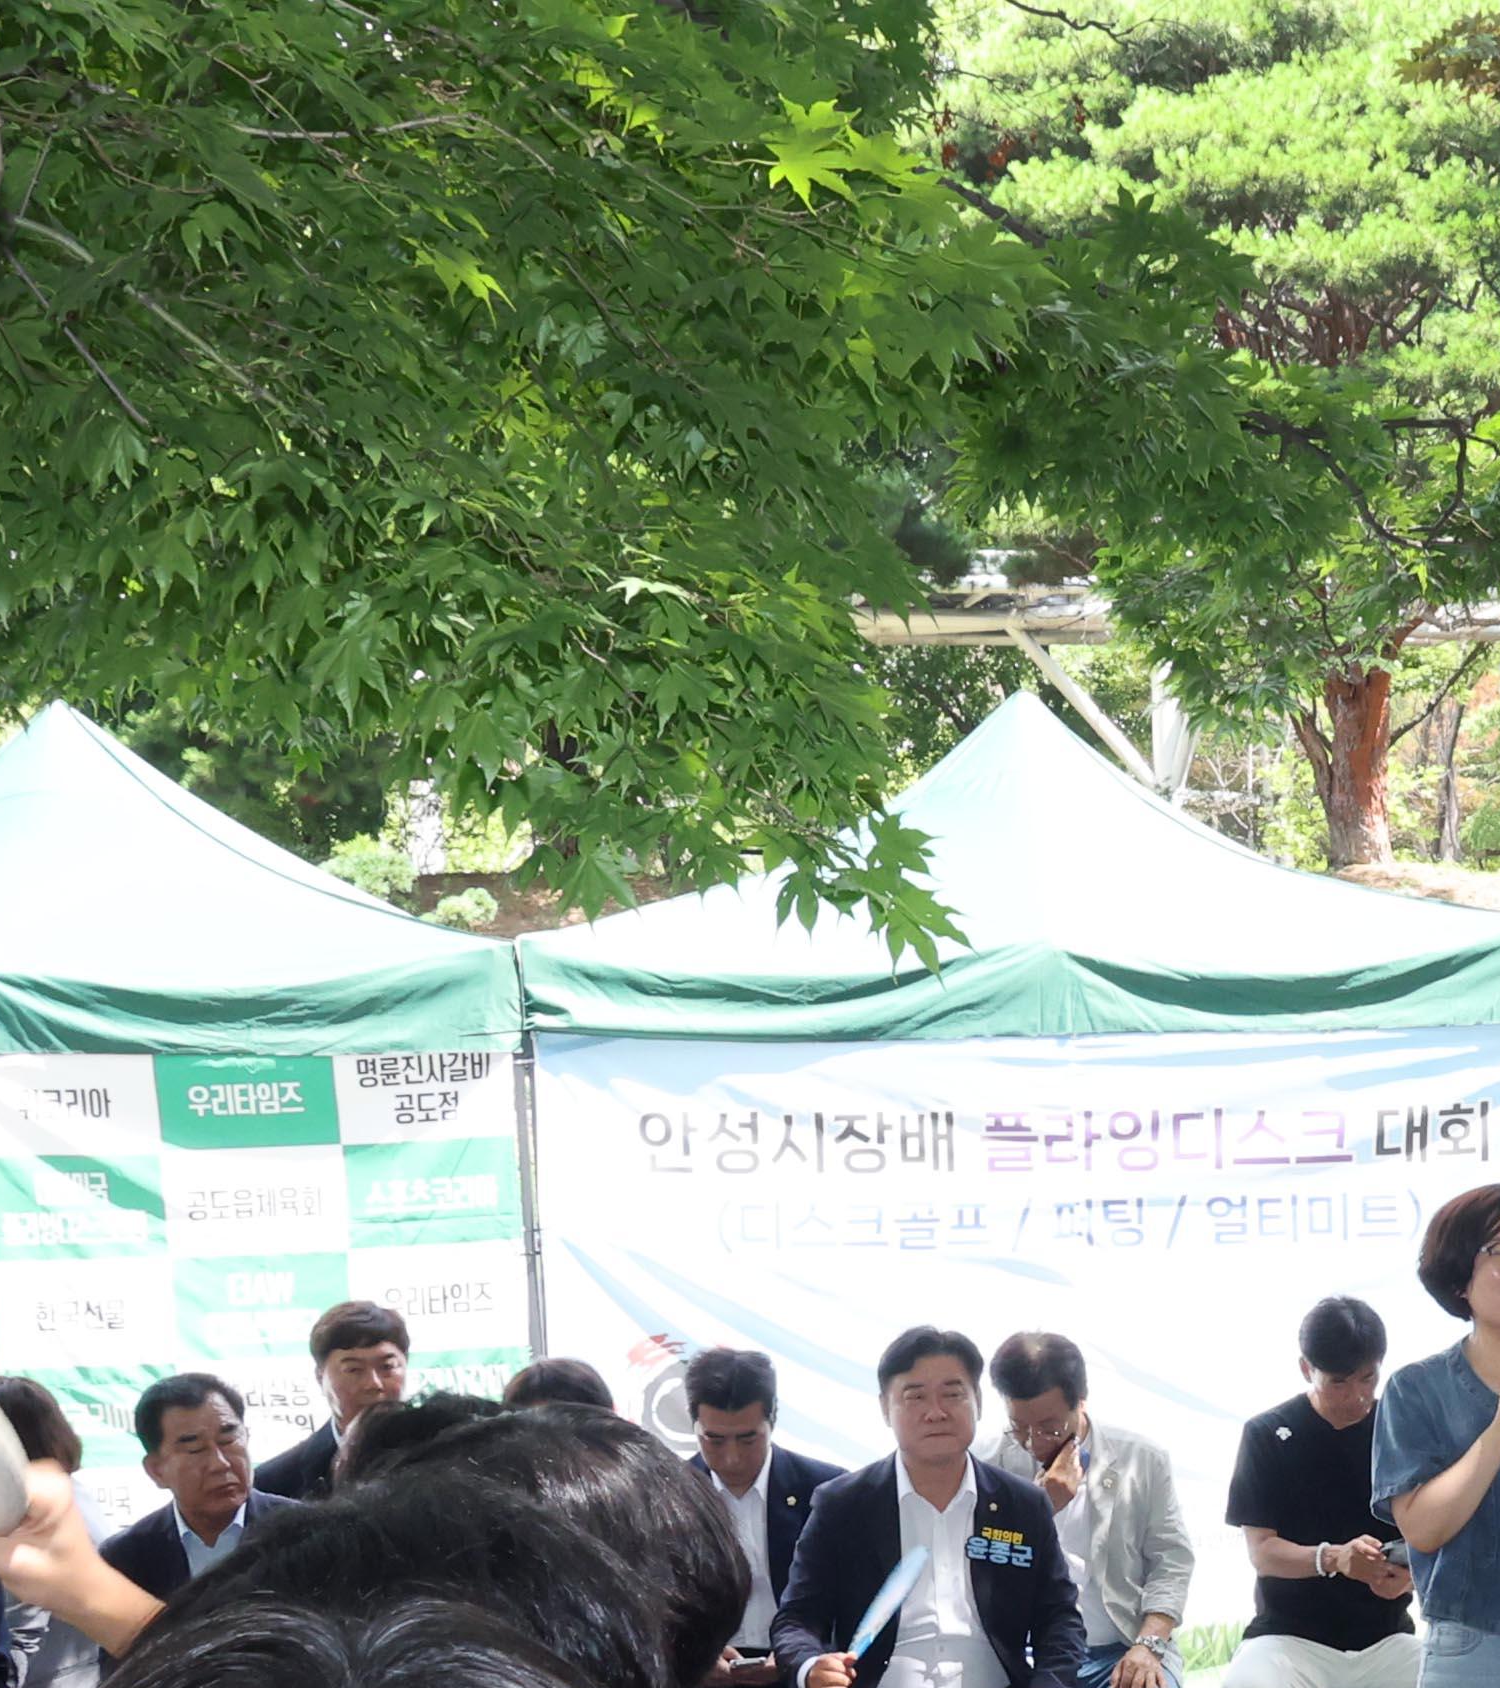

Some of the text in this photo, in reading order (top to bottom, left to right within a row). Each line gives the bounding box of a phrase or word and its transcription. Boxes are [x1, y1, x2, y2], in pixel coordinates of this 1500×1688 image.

[355, 1052, 490, 1089] 명륜진사갈비
[187, 1082, 305, 1117] 우리타임즈
[393, 1092, 459, 1125] 공도점
[638, 1100, 1489, 1174] 안성시장배 플라잉디스크 대회
[187, 1187, 323, 1222] 공도읍체육회
[718, 1188, 1422, 1253] (디스크골프 / 퍼팅 / 얼티미트)
[384, 1280, 494, 1313] 우리타임즈
[35, 1298, 124, 1333] 한국선물
[966, 1536, 1033, 1568] 윤종군
[981, 1526, 1023, 1544] 국회의원
